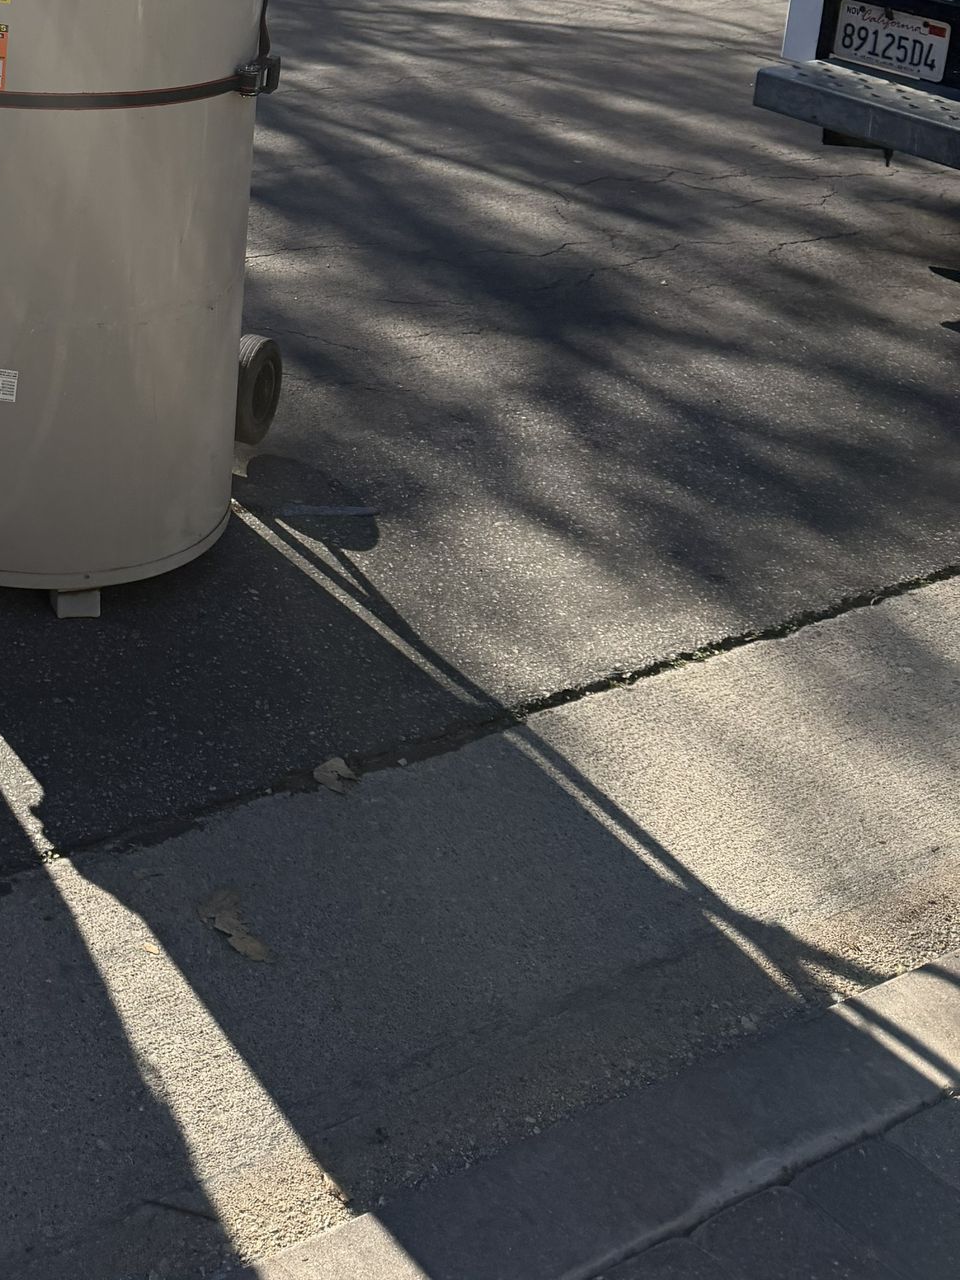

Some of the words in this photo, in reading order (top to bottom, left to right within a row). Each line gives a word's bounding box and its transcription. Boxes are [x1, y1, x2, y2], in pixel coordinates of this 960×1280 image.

[846, 6, 860, 16] NOV
[861, 9, 929, 36] California
[841, 22, 936, 72] 89125D4
